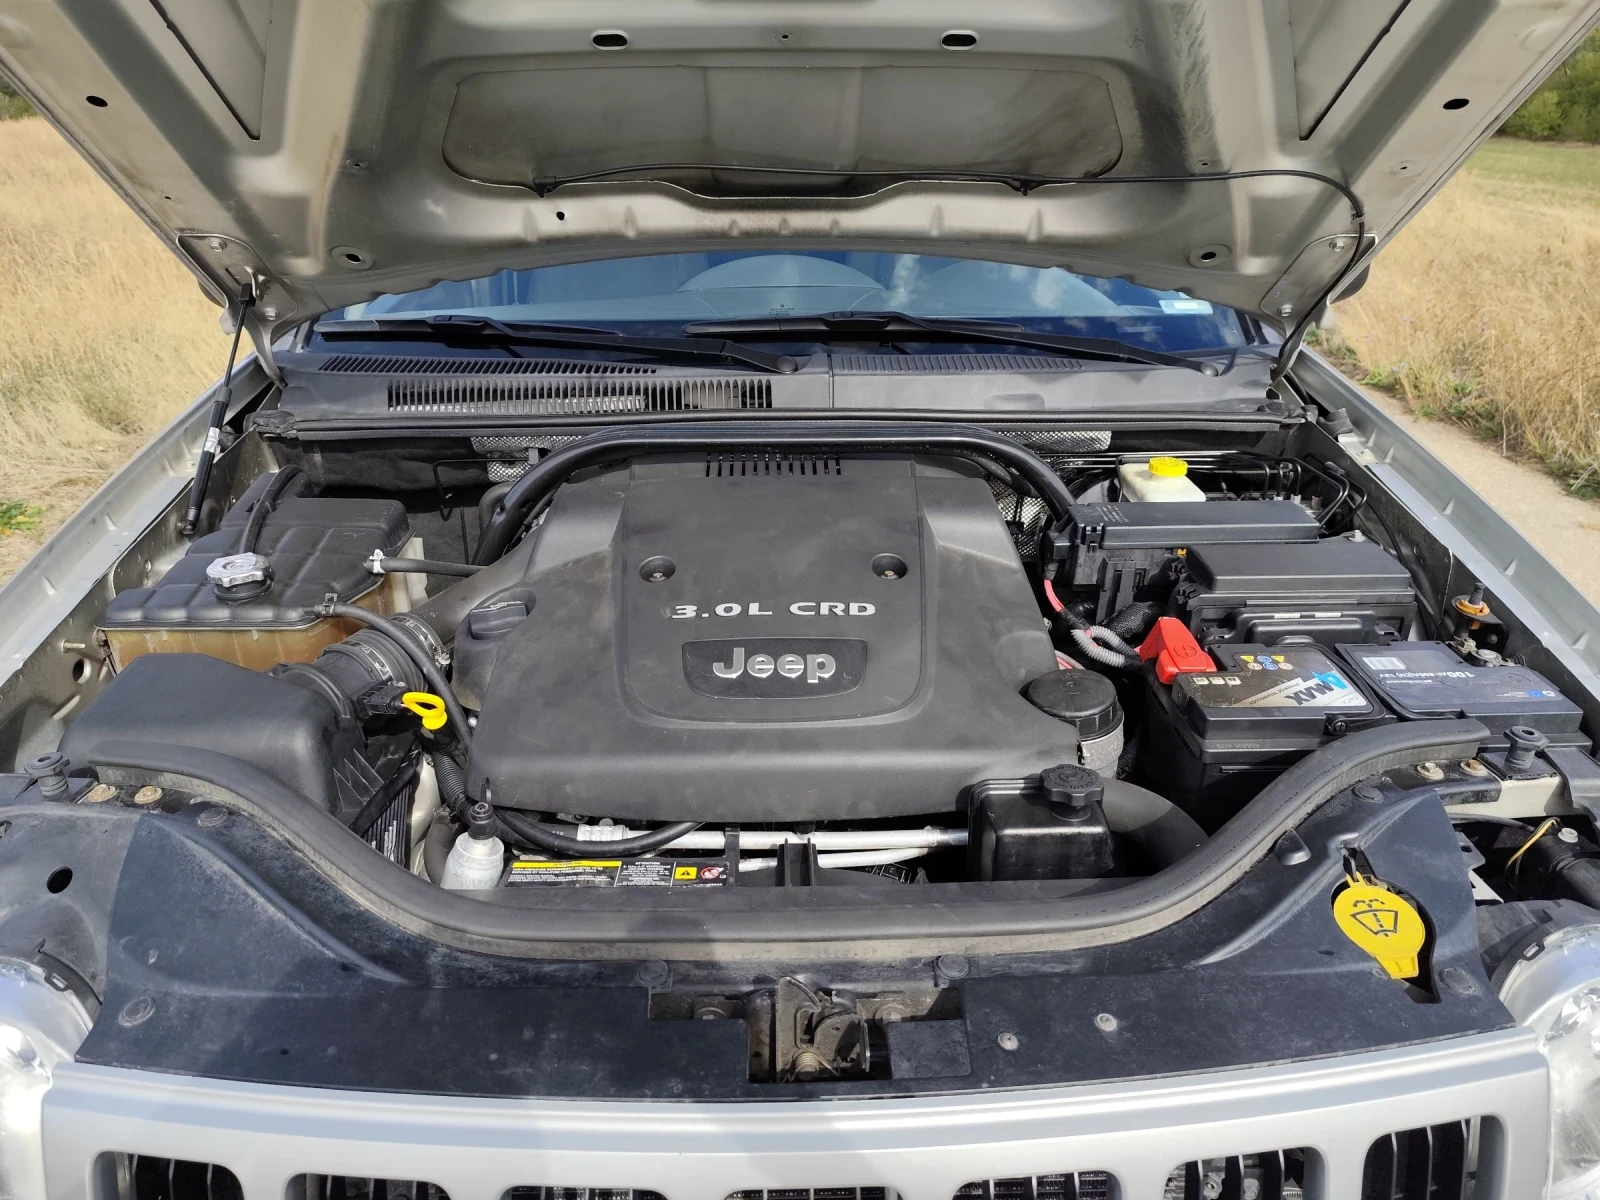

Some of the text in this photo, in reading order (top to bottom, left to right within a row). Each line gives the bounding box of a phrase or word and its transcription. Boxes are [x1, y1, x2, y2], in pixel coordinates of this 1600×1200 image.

[672, 602, 876, 619] 3.0L CRD
[712, 647, 836, 684] Jeep
